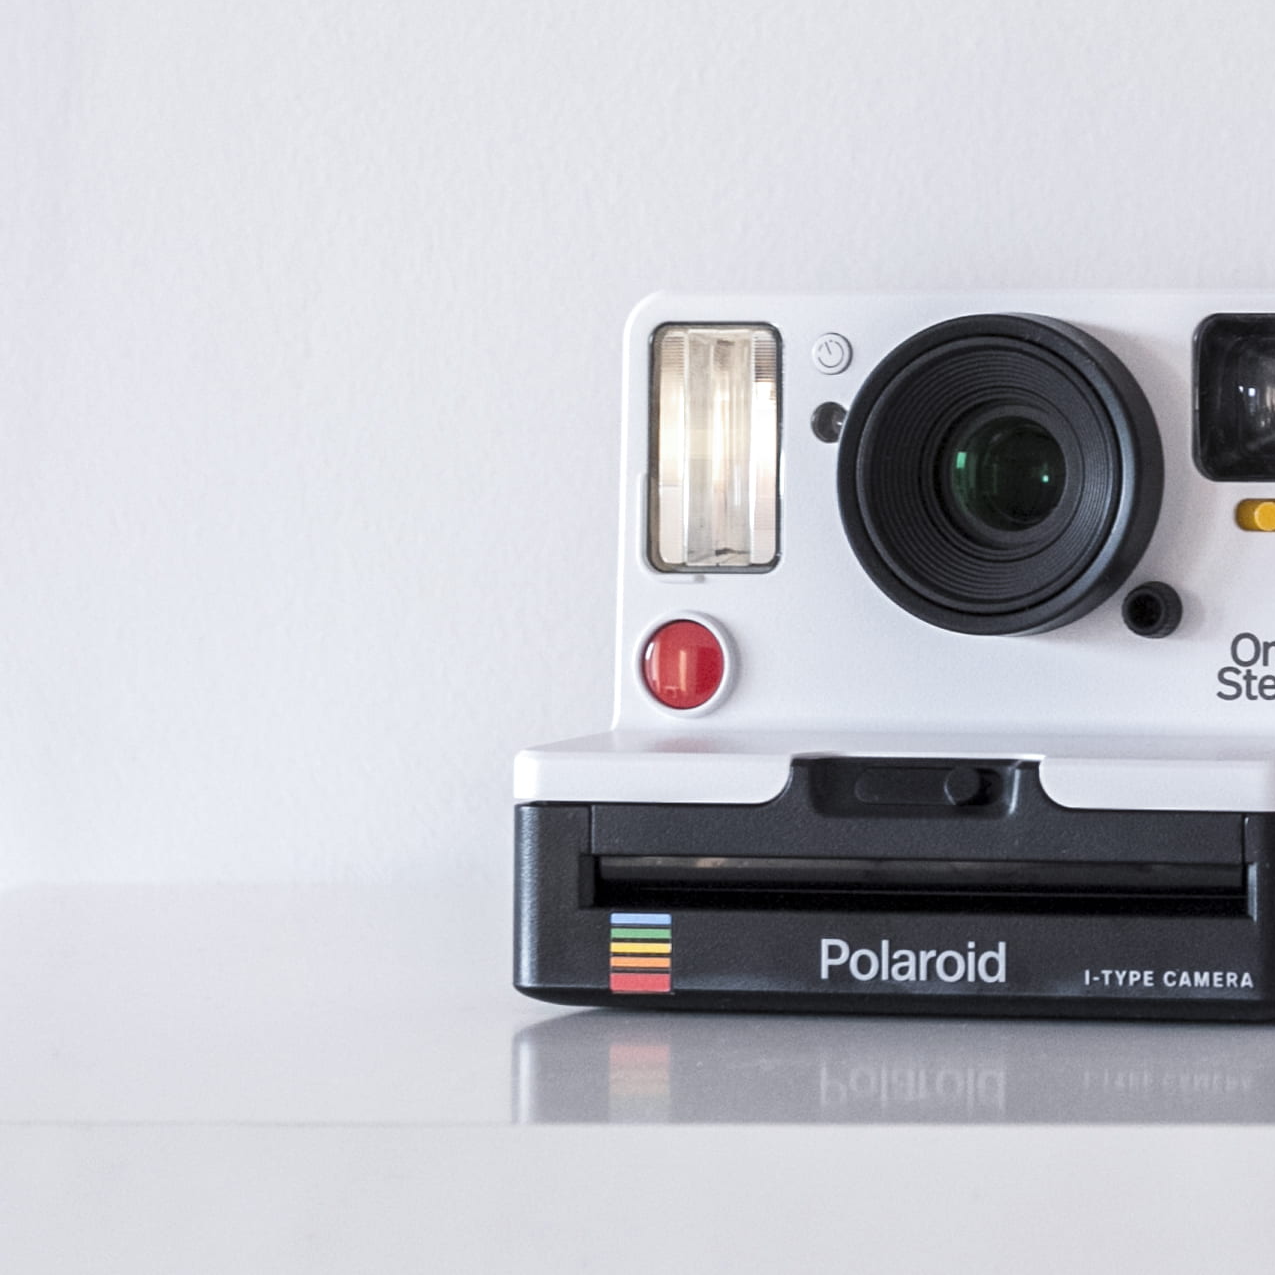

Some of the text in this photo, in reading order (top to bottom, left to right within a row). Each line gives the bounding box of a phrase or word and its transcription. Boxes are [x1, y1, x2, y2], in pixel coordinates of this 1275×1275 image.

[820, 938, 1007, 983] Polaroid
[1084, 969, 1254, 988] I-TYPE CAMERA
